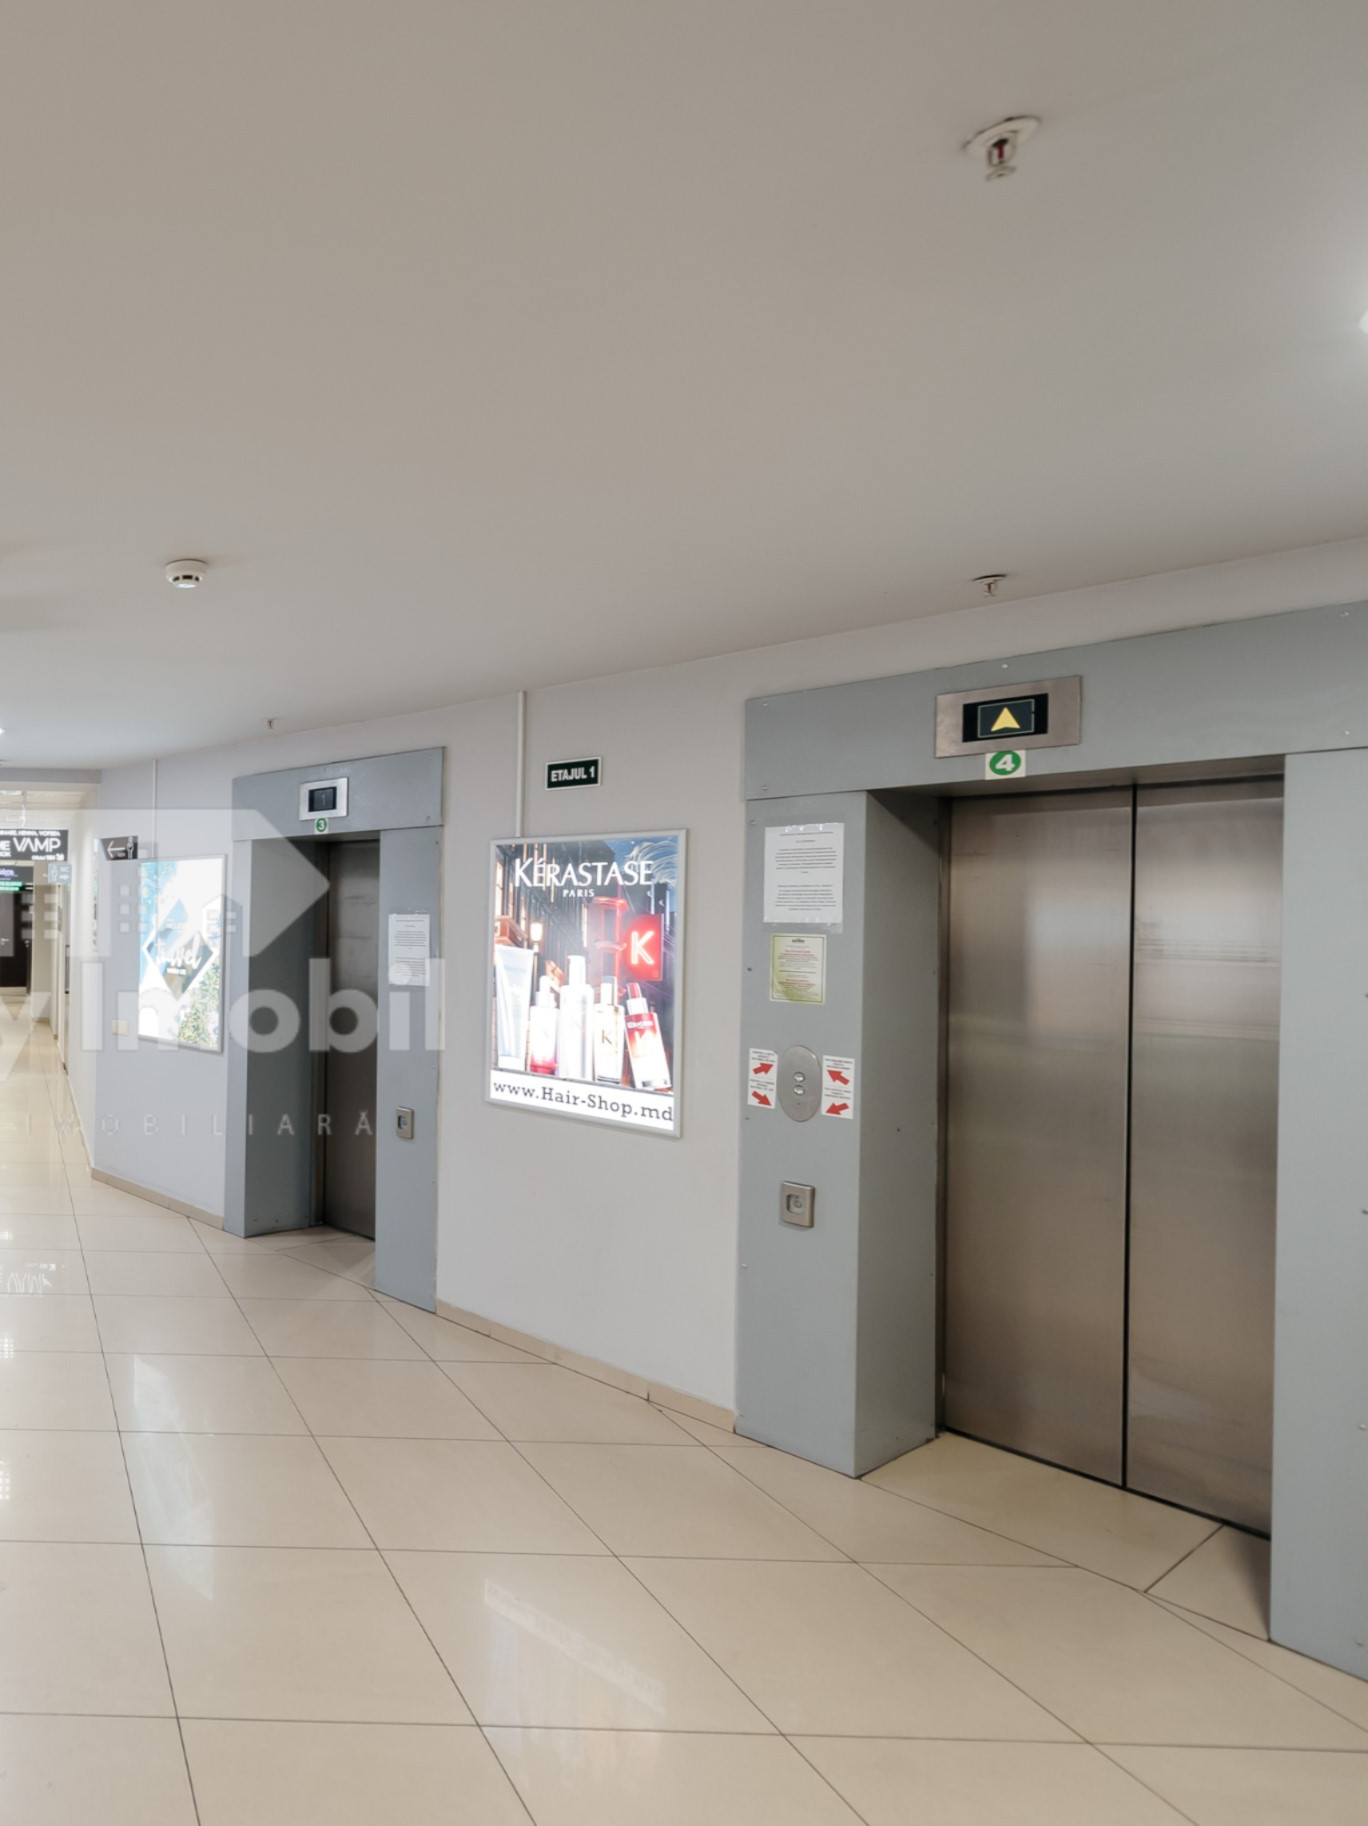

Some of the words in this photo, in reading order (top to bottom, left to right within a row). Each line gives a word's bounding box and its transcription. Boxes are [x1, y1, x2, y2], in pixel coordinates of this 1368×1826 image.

[994, 754, 1016, 771] 4
[550, 767, 588, 782] ETAJUL
[588, 765, 595, 779] 1
[318, 821, 325, 831] 3
[13, 837, 61, 852] VAMP
[514, 858, 654, 887] KÉRASTASE
[563, 888, 595, 898] PARIS
[630, 930, 655, 965] K
[493, 1082, 673, 1122] www.Hair-Shop.md
